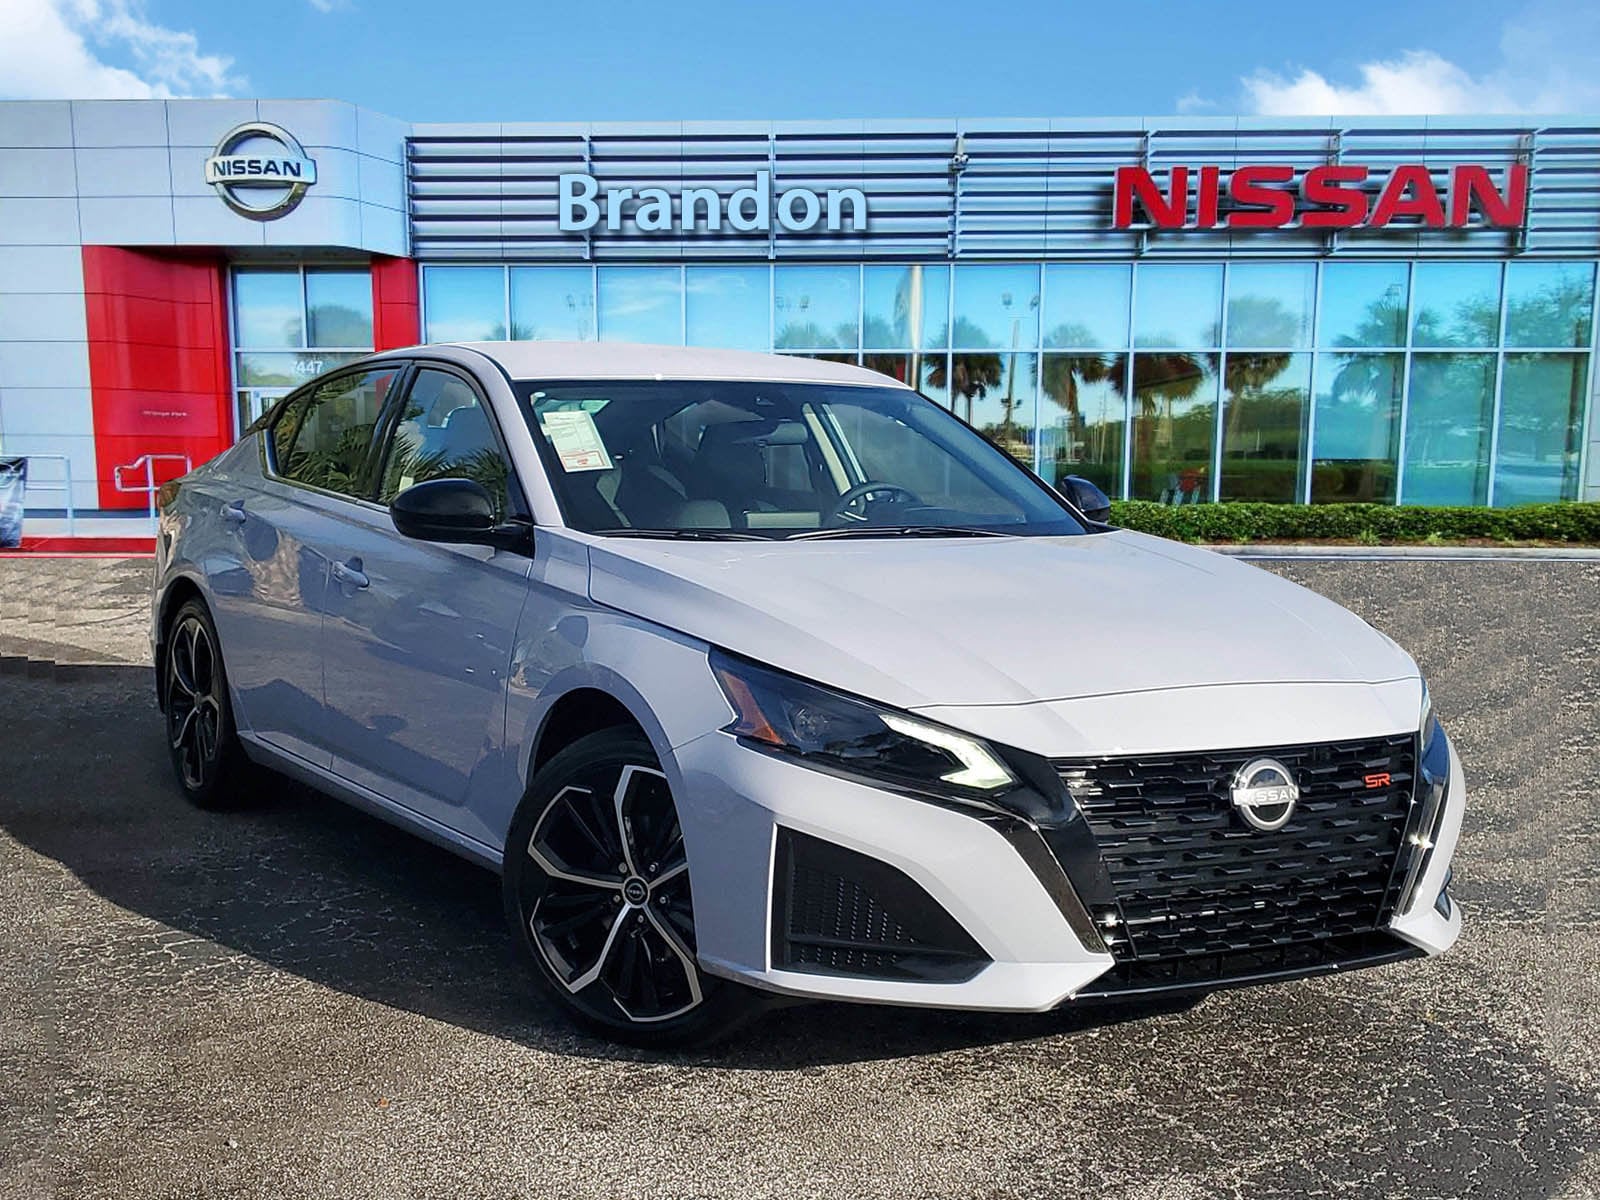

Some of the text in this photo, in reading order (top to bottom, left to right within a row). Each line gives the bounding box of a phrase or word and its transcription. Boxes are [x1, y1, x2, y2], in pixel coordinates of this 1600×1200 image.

[213, 159, 301, 177] NISSAN
[559, 170, 867, 232] Brandon
[1112, 164, 1528, 229] NISSAN
[1364, 772, 1392, 788] SR
[1236, 786, 1299, 803] SSAN
